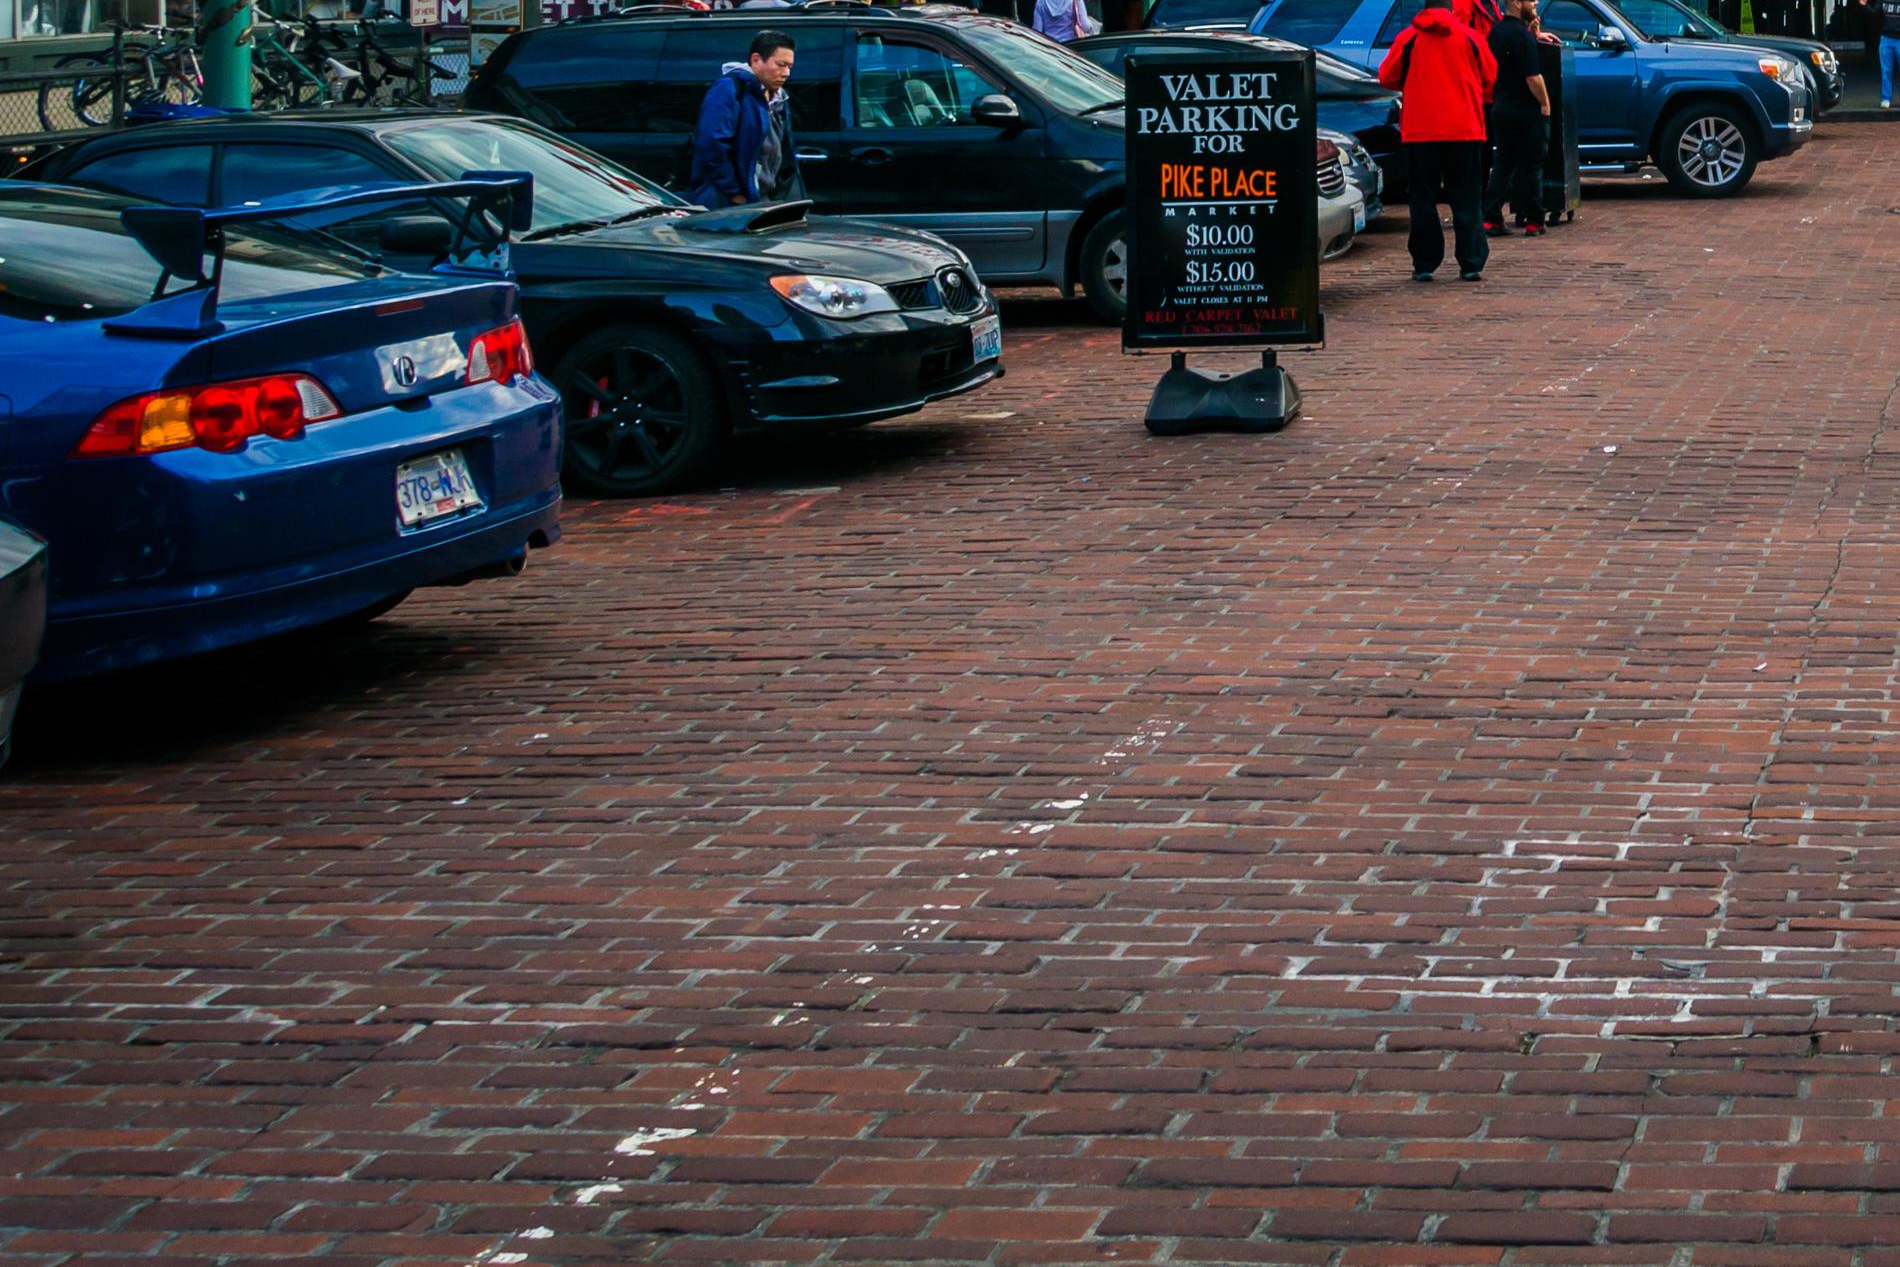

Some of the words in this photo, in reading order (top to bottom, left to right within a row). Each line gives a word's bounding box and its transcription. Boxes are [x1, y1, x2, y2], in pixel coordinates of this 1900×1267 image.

[1160, 73, 1277, 101] VALET
[1137, 104, 1300, 134] PARKING
[1193, 135, 1245, 154] FOR
[1161, 164, 1204, 198] PIKE
[1211, 167, 1277, 197] PLACE
[1165, 206, 1276, 217] MARKET
[1186, 223, 1254, 247] $10.00
[1184, 248, 1207, 256] WITH
[1211, 247, 1256, 255] VALIDATION
[1186, 260, 1255, 284] $15.00
[1177, 285, 1215, 293] WITHOUT
[1219, 283, 1265, 291] VALIDATION
[1174, 297, 1197, 305] VALET
[1201, 296, 1229, 304] CLOSES
[1232, 296, 1243, 304] AT
[1257, 295, 1268, 303] PM
[1145, 310, 1177, 323] RED
[1185, 309, 1243, 322] CARPET
[1253, 307, 1298, 320] VALET
